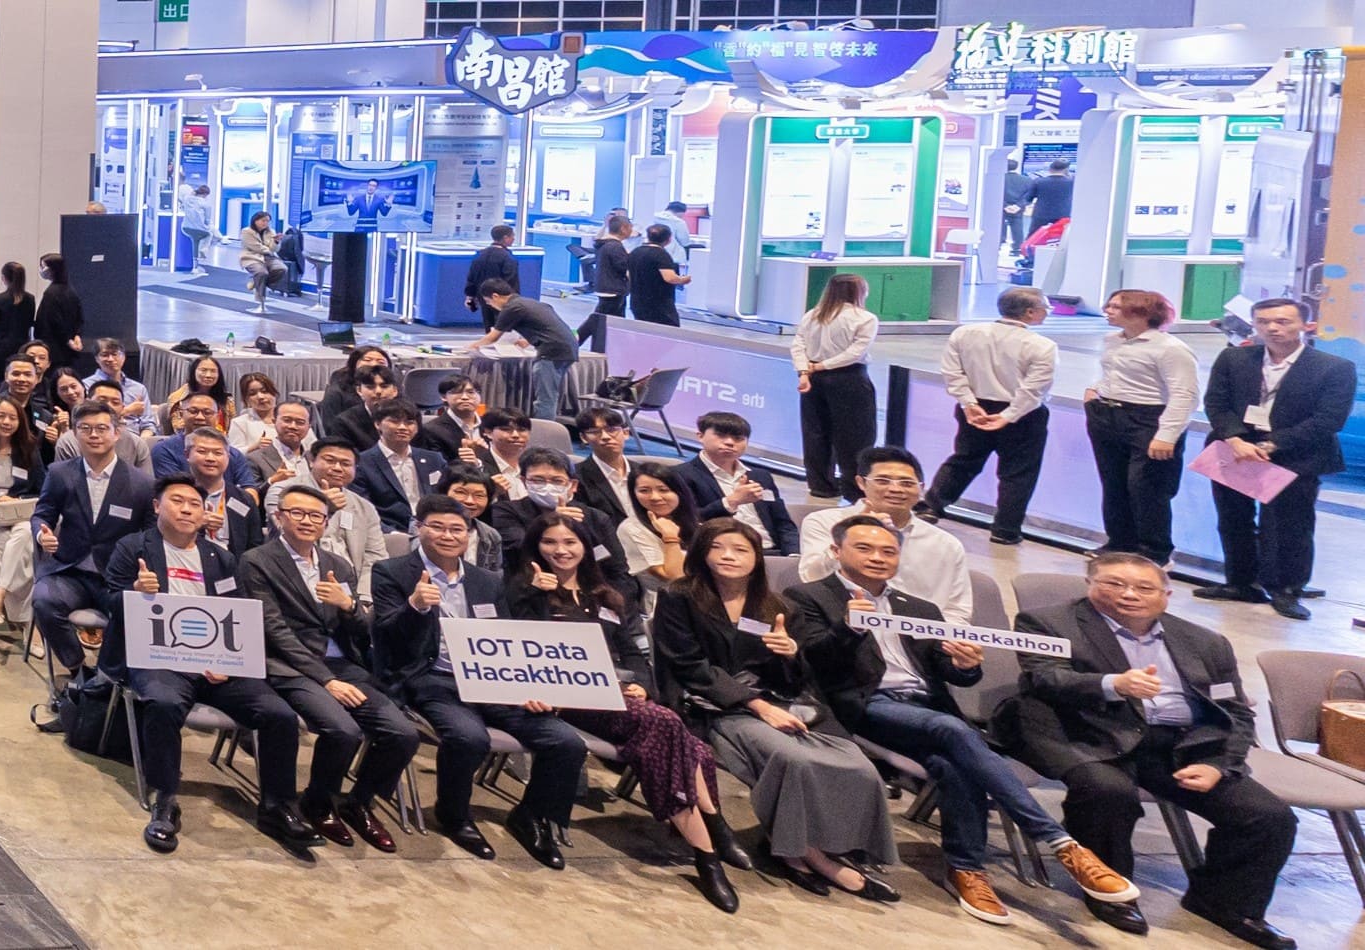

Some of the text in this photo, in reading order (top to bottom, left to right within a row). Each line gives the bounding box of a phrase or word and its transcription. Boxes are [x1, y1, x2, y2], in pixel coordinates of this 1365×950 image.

[456, 31, 570, 109] 南昌館
[860, 615, 1064, 653] IOT Data Hackathon
[150, 654, 244, 666] Industry Advisory Council
[467, 637, 589, 661] IOT Data
[461, 661, 609, 687] Hacakthon
